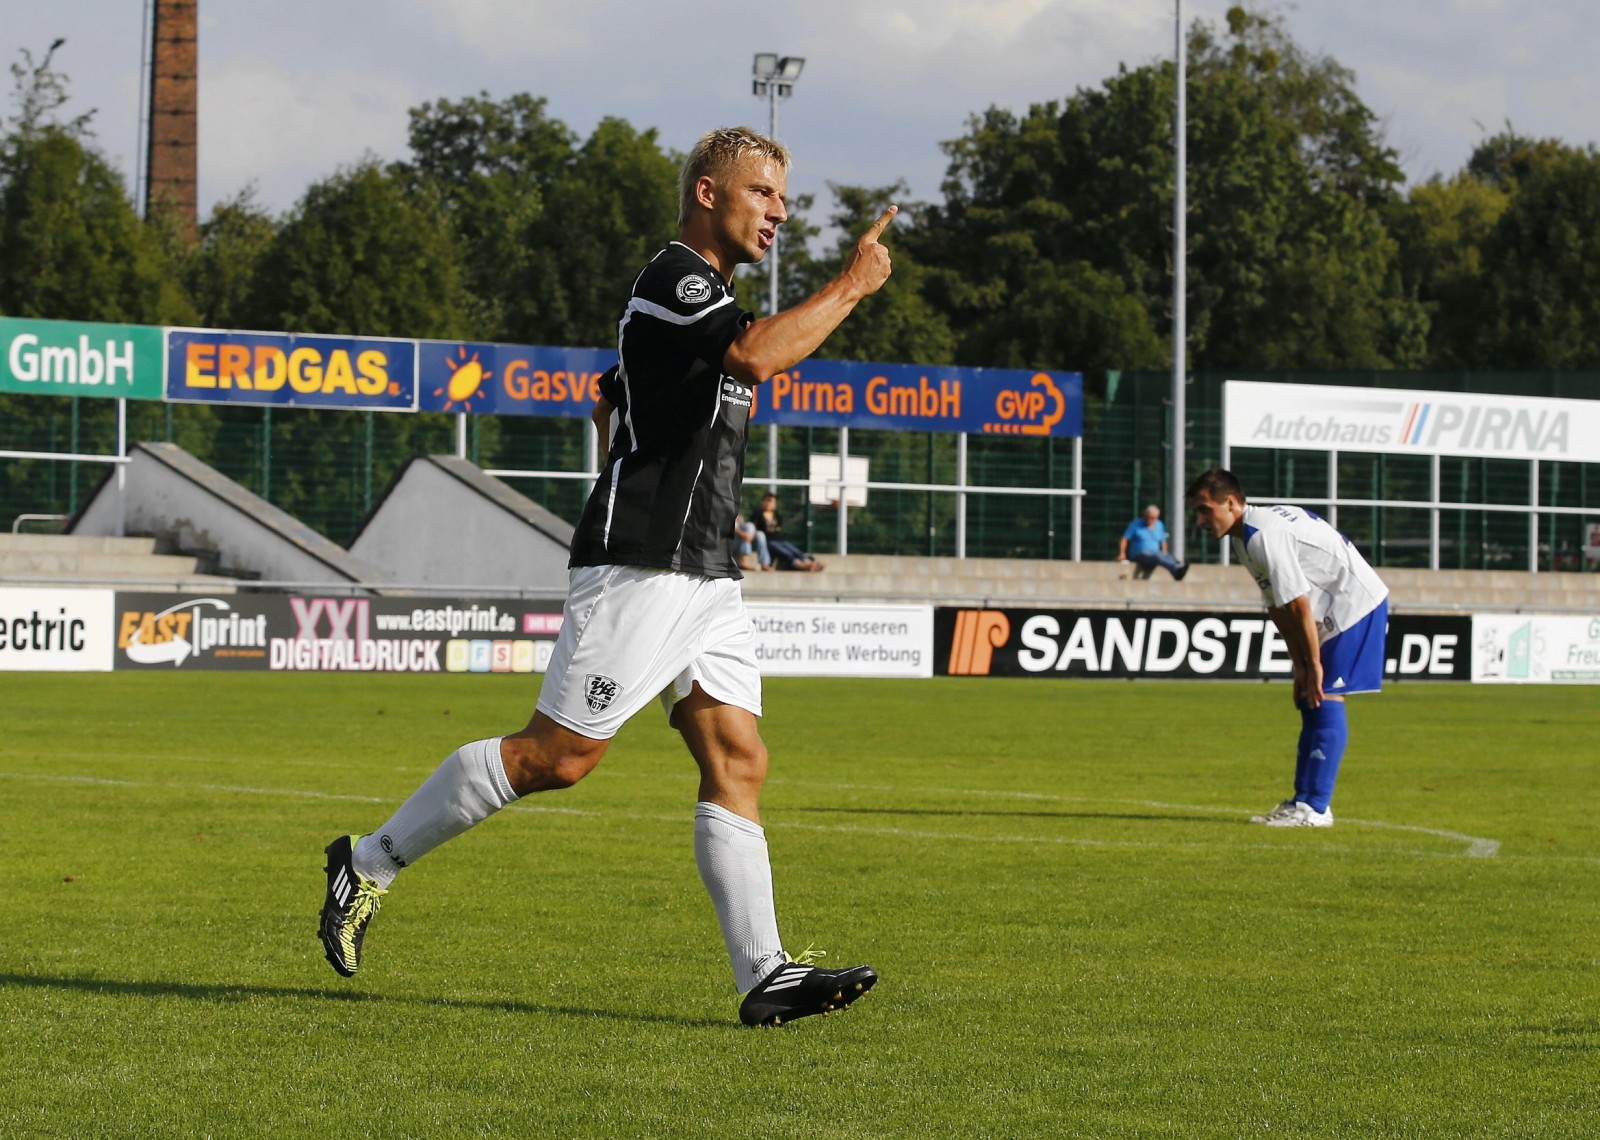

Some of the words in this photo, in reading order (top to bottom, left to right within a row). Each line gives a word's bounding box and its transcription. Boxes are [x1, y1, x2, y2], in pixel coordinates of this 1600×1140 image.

[8, 333, 135, 386] GmbH
[185, 342, 401, 396] ERDGAS.
[771, 370, 854, 414] Pirna
[865, 376, 962, 418] GmbH
[996, 389, 1046, 421] GVP
[1251, 412, 1393, 445] Autohaus
[1427, 403, 1571, 453] PIRNA
[117, 611, 193, 649] EAST
[375, 604, 516, 638] www.eastprint.de
[812, 617, 836, 634] Sie
[841, 621, 908, 634] unseren
[269, 637, 442, 672] DIGITALDRUCK
[755, 643, 801, 661] durch
[807, 645, 840, 661] Ihre
[845, 645, 922, 667] Werbung
[591, 701, 602, 710] 07
